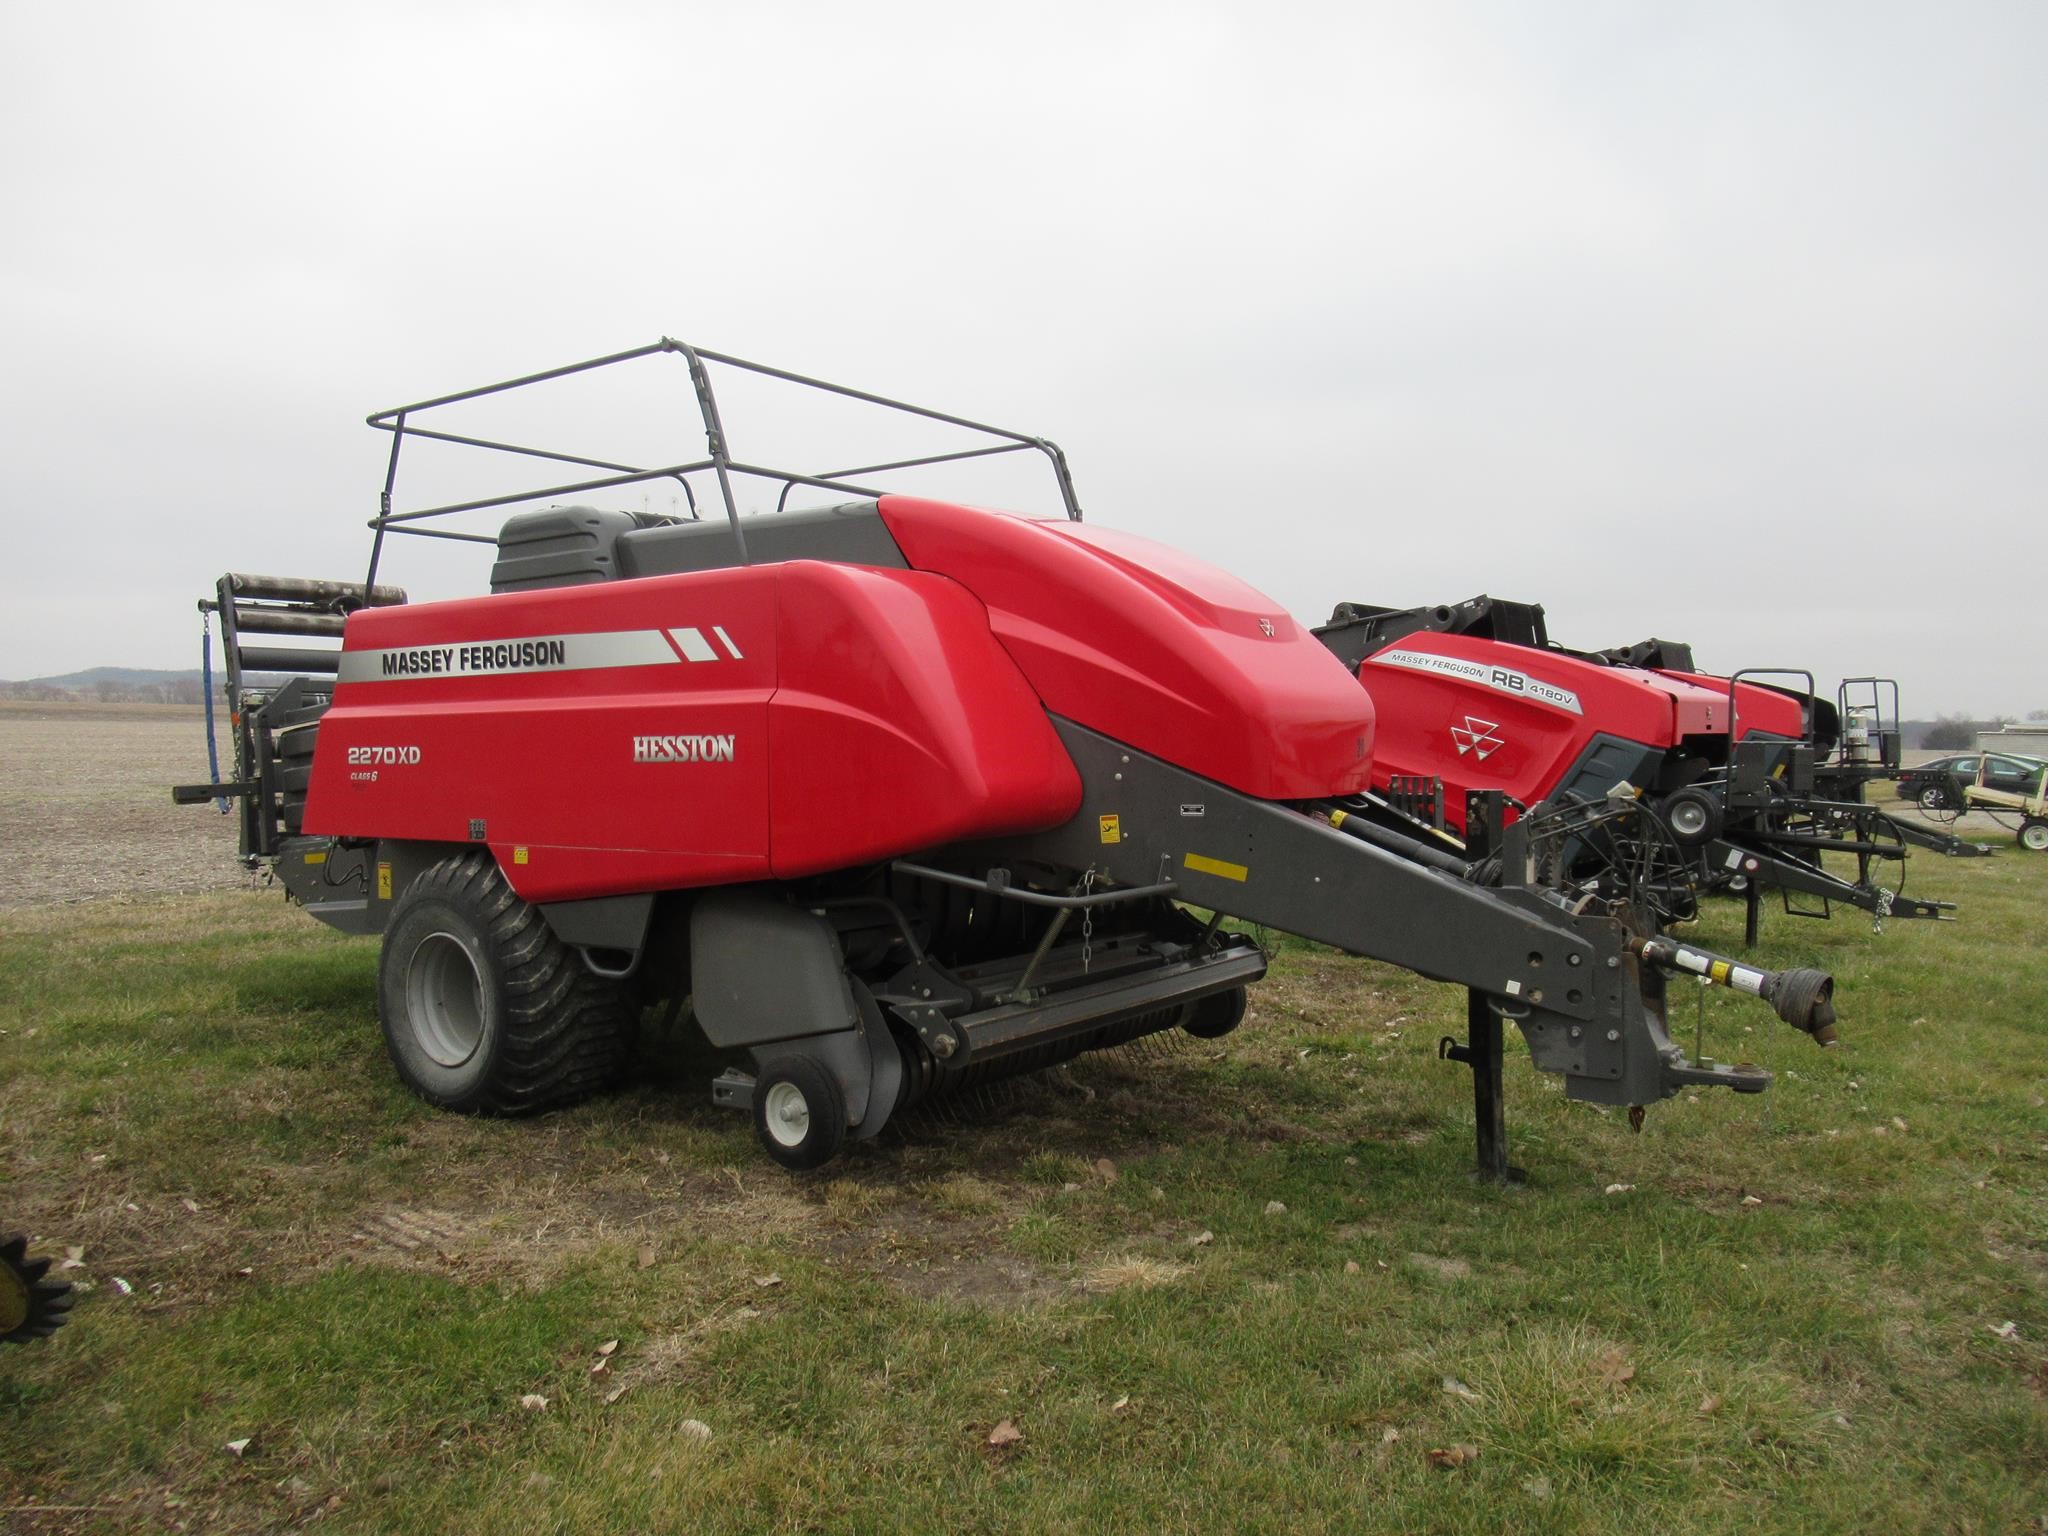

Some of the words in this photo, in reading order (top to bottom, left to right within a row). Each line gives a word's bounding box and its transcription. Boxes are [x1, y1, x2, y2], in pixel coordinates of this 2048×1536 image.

[382, 648, 454, 675] MASSEY
[459, 640, 565, 671] FERGUSON
[1391, 653, 1430, 666] MASSEY
[1432, 659, 1485, 678] FERGUSON
[1491, 669, 1524, 691] RB
[1529, 684, 1573, 704] 4180V
[633, 734, 736, 762] HESSTON
